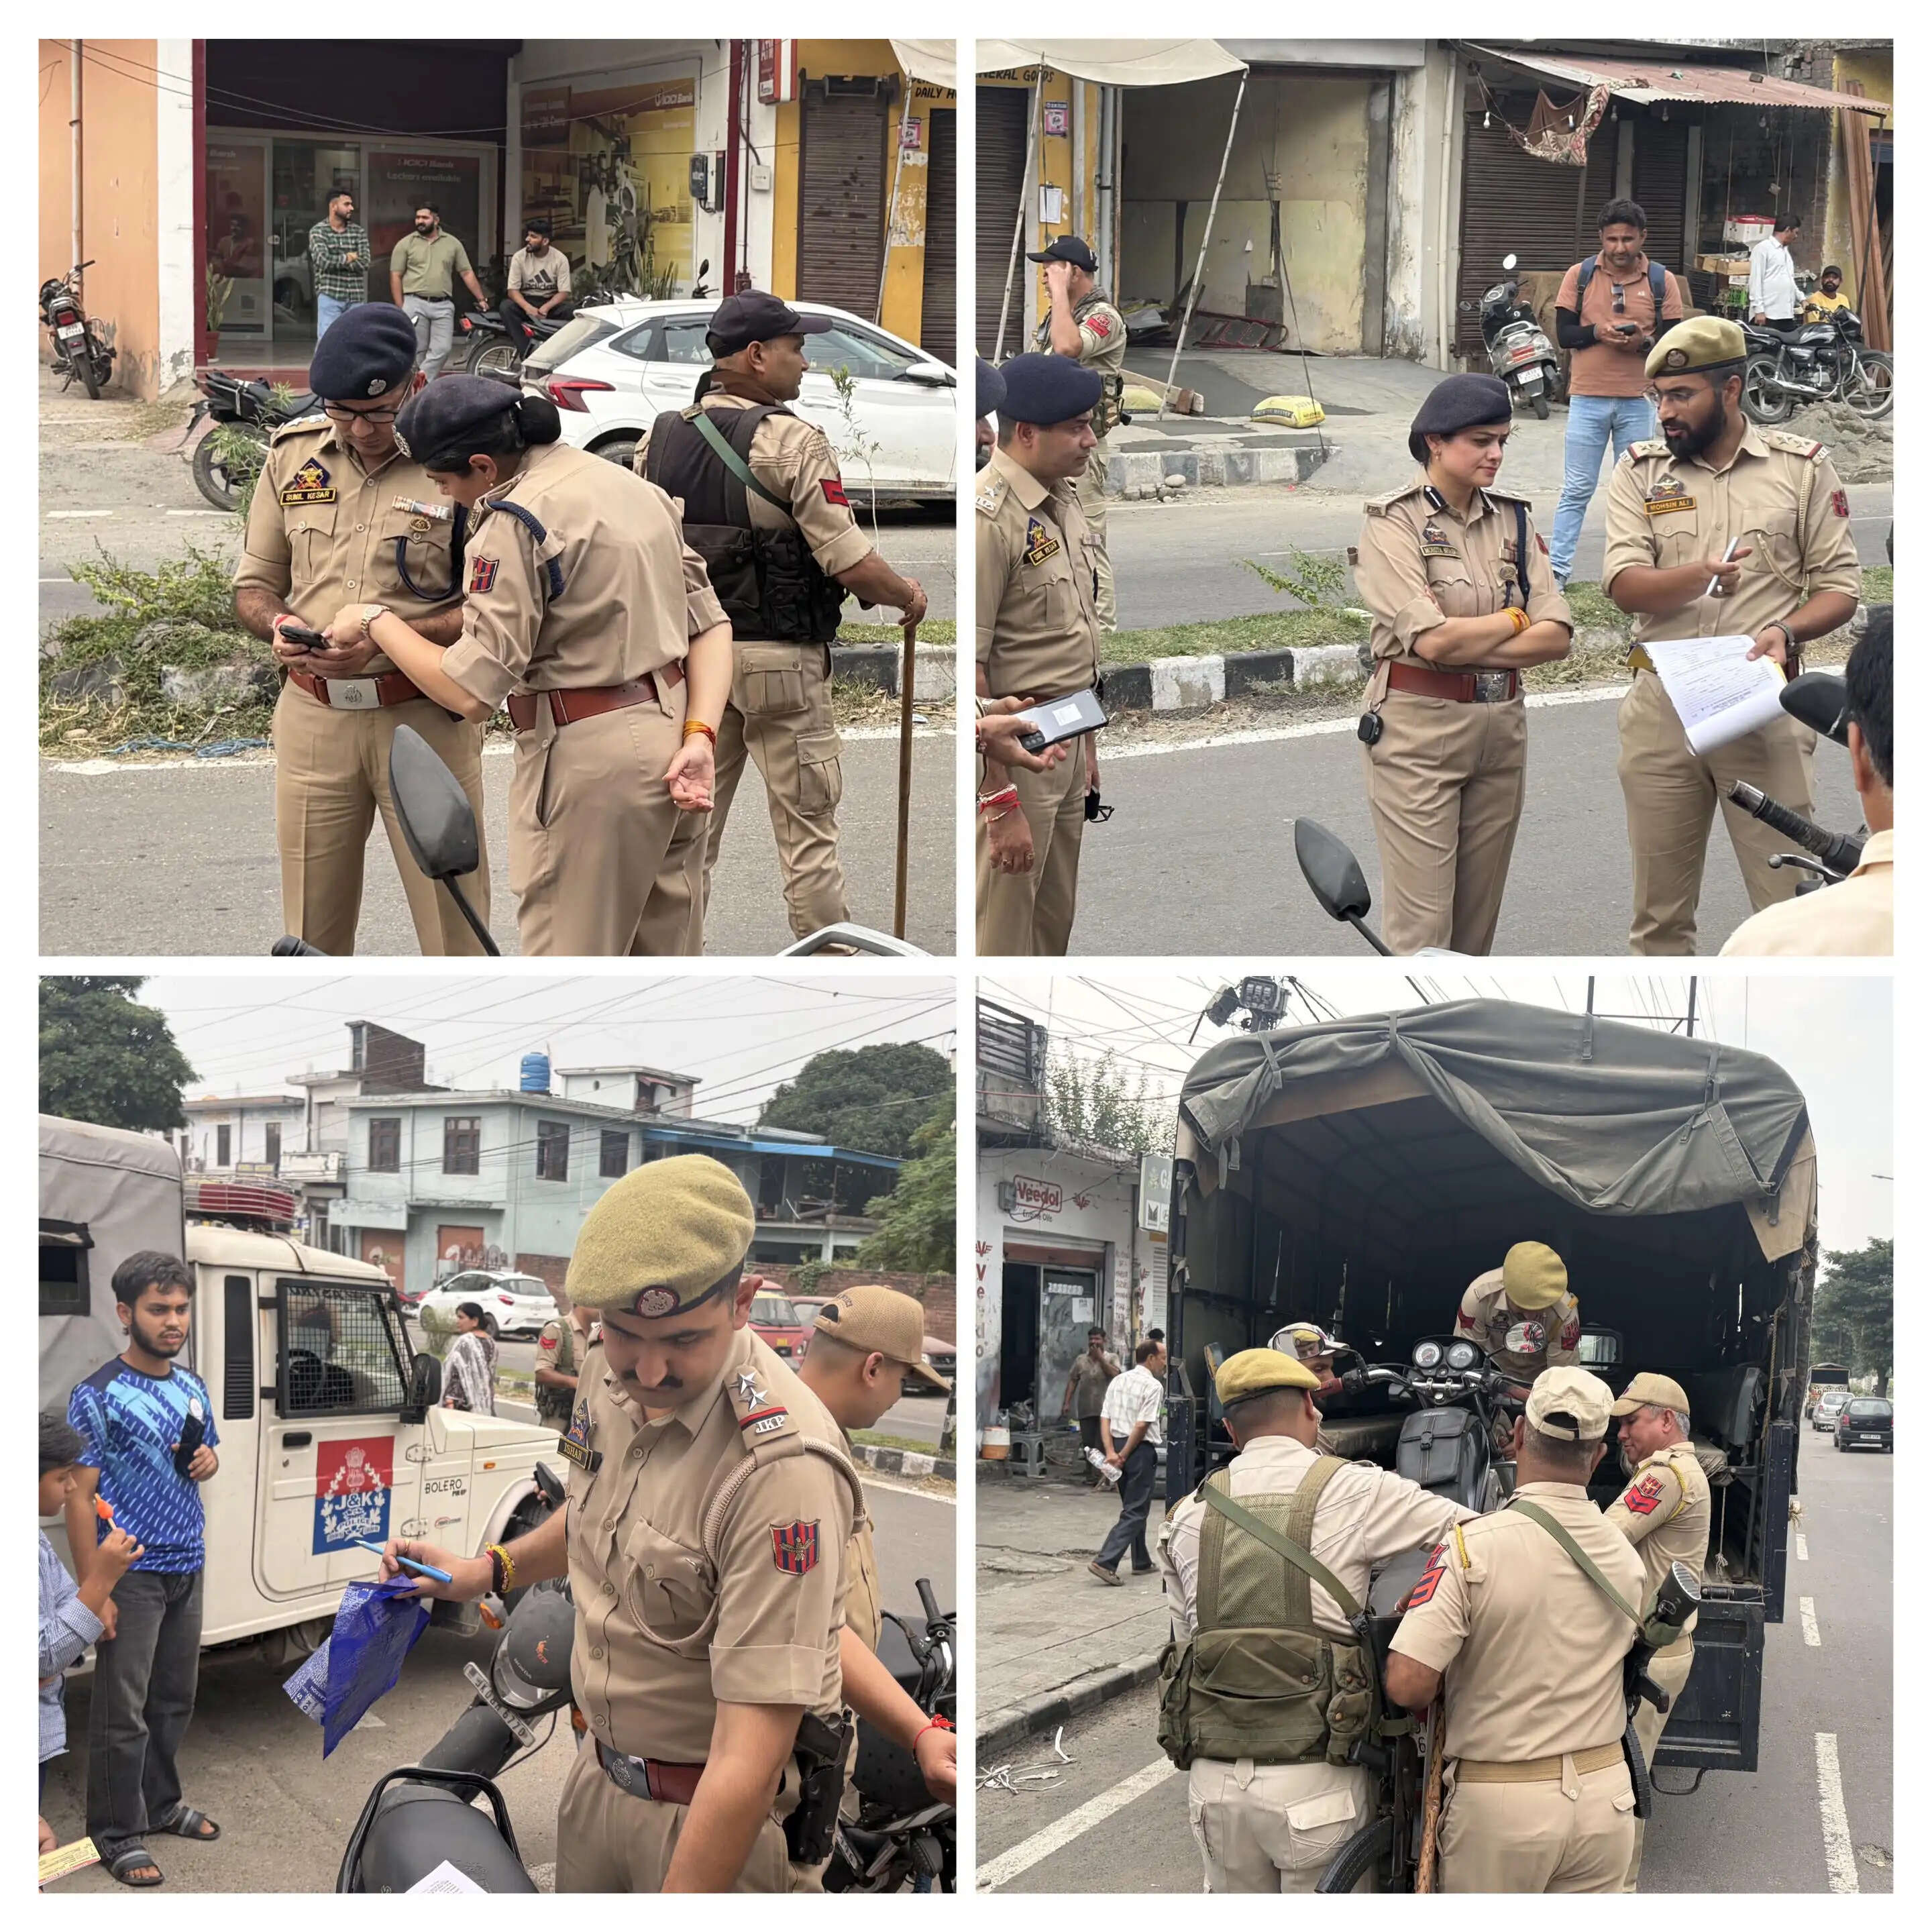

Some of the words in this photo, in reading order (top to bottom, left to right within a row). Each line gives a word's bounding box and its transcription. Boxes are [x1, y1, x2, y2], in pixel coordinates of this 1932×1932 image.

[975, 69, 1018, 81] NERAL
[915, 87, 943, 99] DAILY
[947, 89, 957, 99] H
[307, 491, 329, 500] KESAR
[1650, 500, 1678, 511] MOHSIN
[1018, 1182, 1059, 1207] Veedol
[755, 1415, 785, 1434] JKP
[425, 1479, 462, 1495] BOLERO
[335, 1491, 373, 1510] J&K
